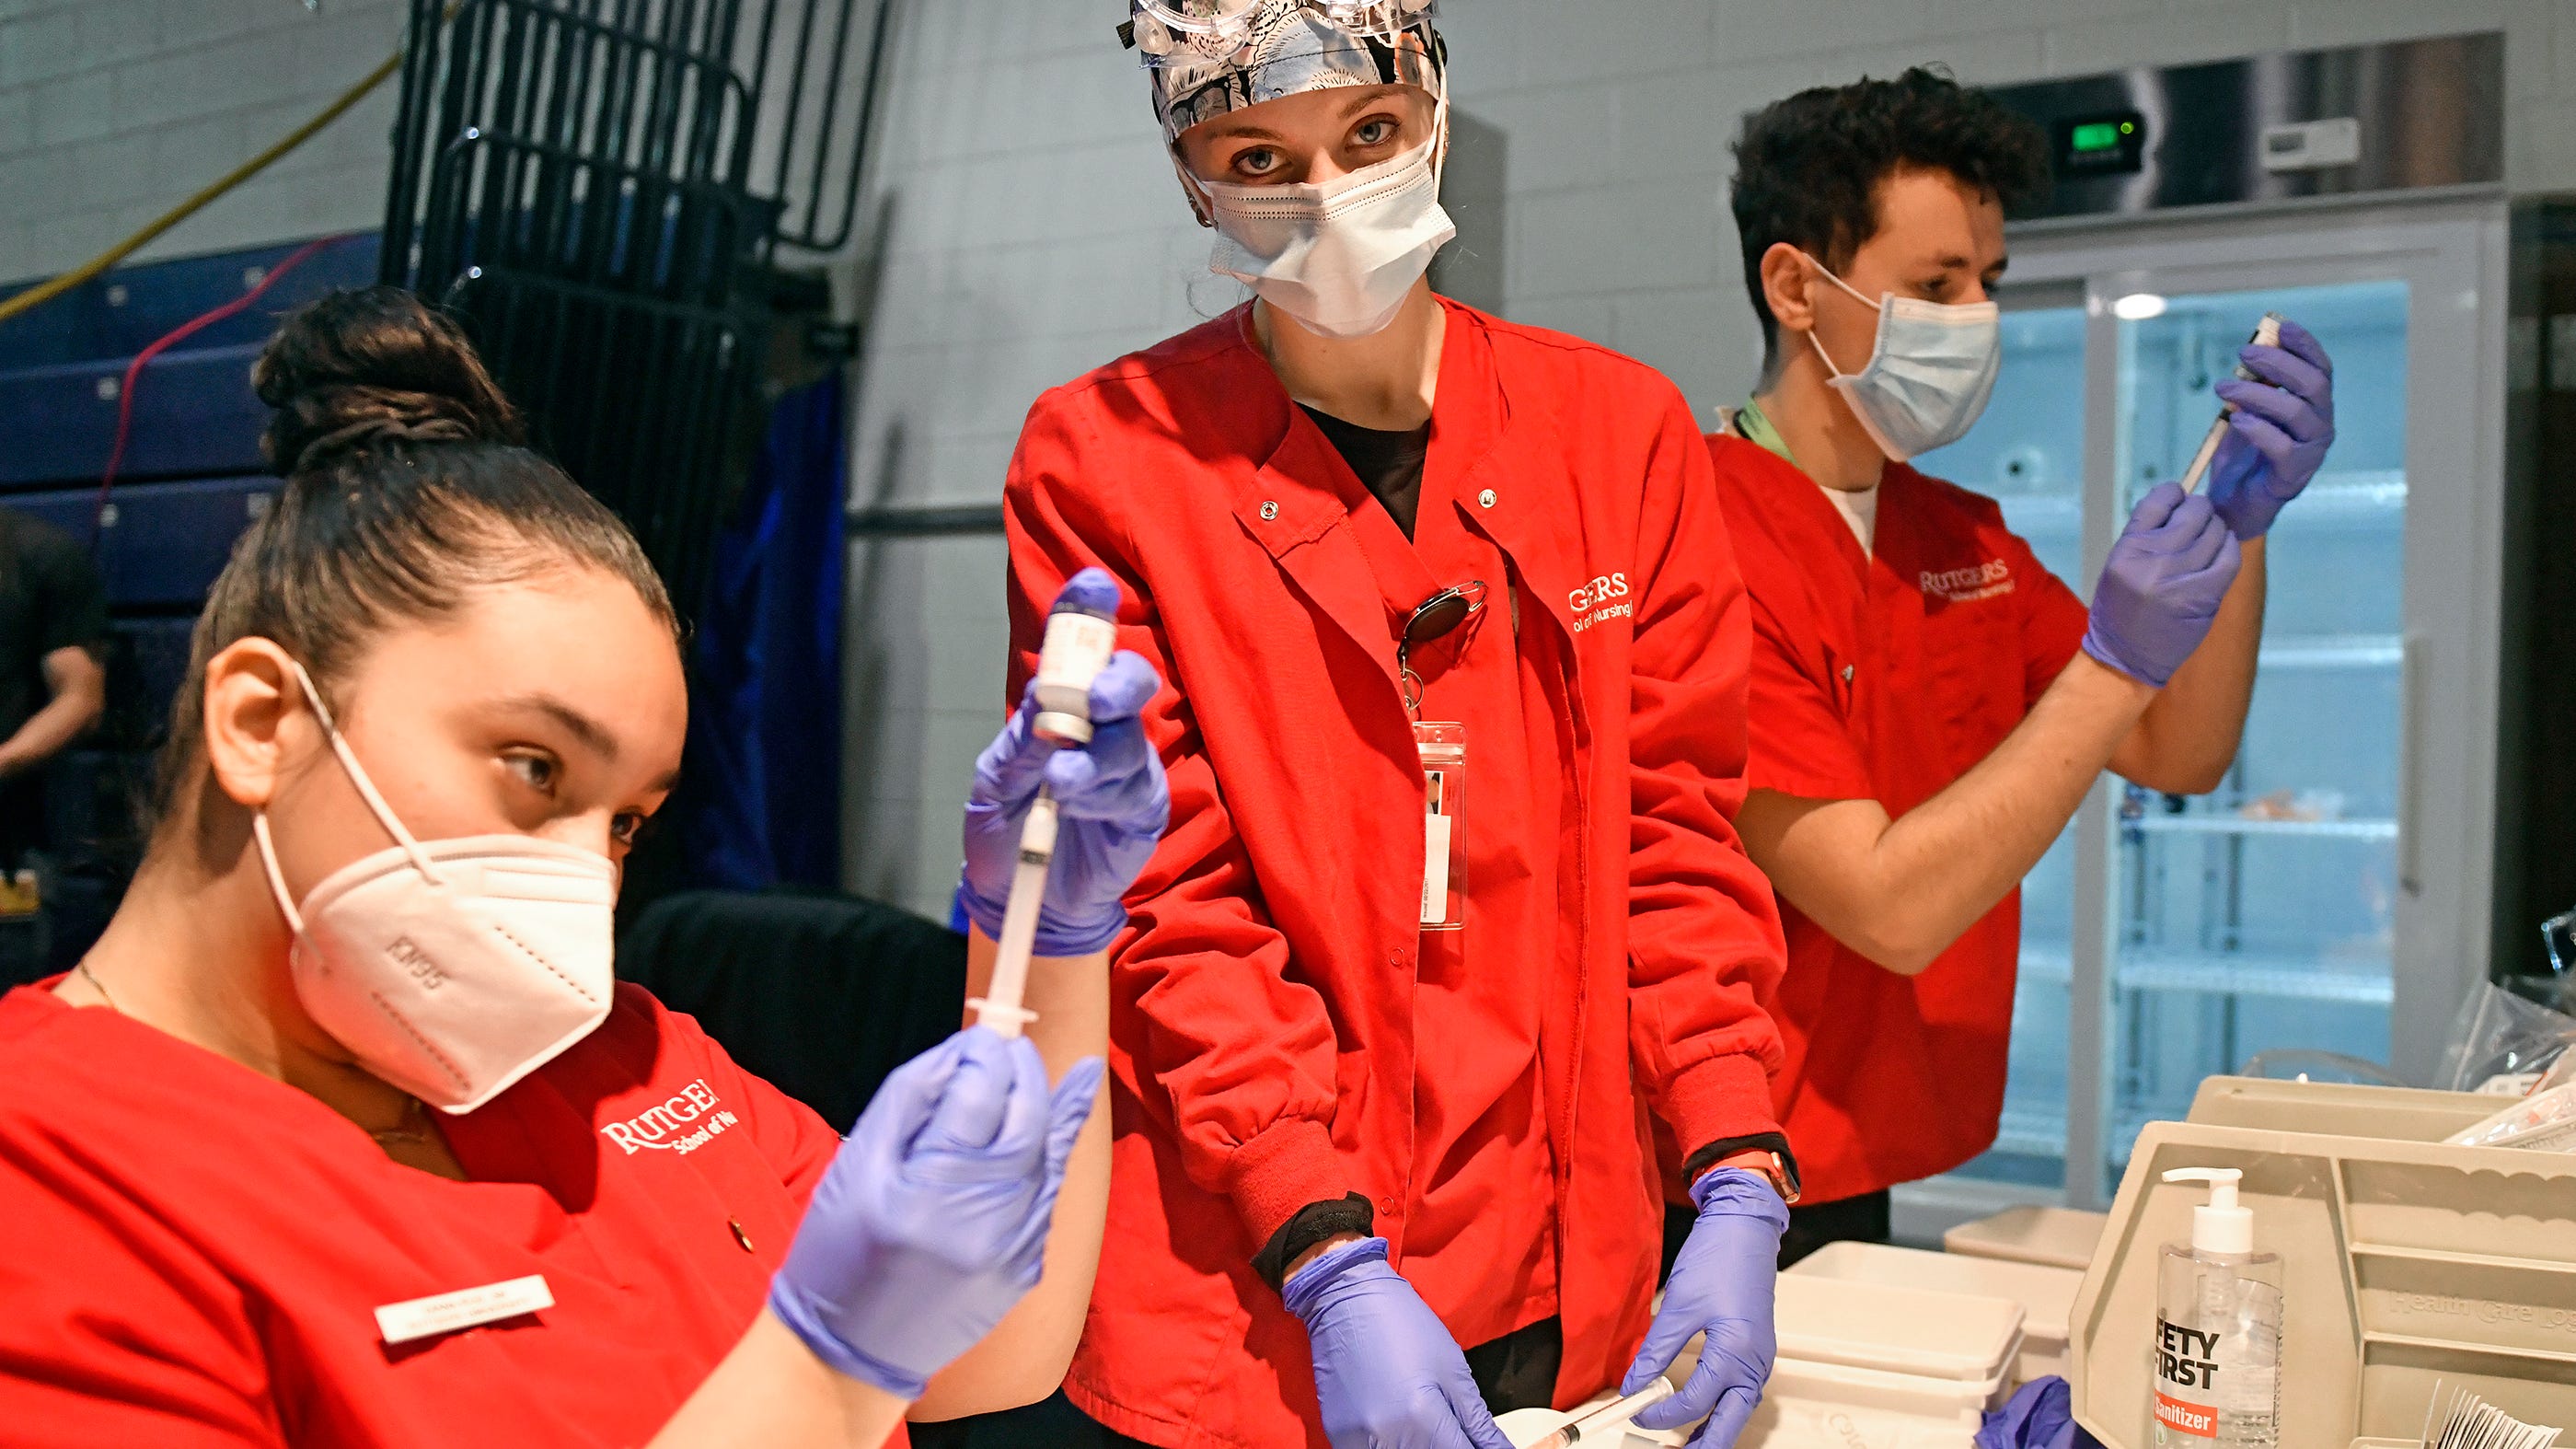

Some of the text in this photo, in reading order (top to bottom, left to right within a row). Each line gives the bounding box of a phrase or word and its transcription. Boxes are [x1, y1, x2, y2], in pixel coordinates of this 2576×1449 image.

[1919, 558, 2008, 598] RUTGERS
[1593, 603, 1631, 623] Nursing
[386, 934, 453, 991] KN95
[671, 1125, 714, 1155] School
[707, 1115, 725, 1135] of
[2477, 1300, 2534, 1324] Care
[2154, 1395, 2212, 1431] Sanitizer
